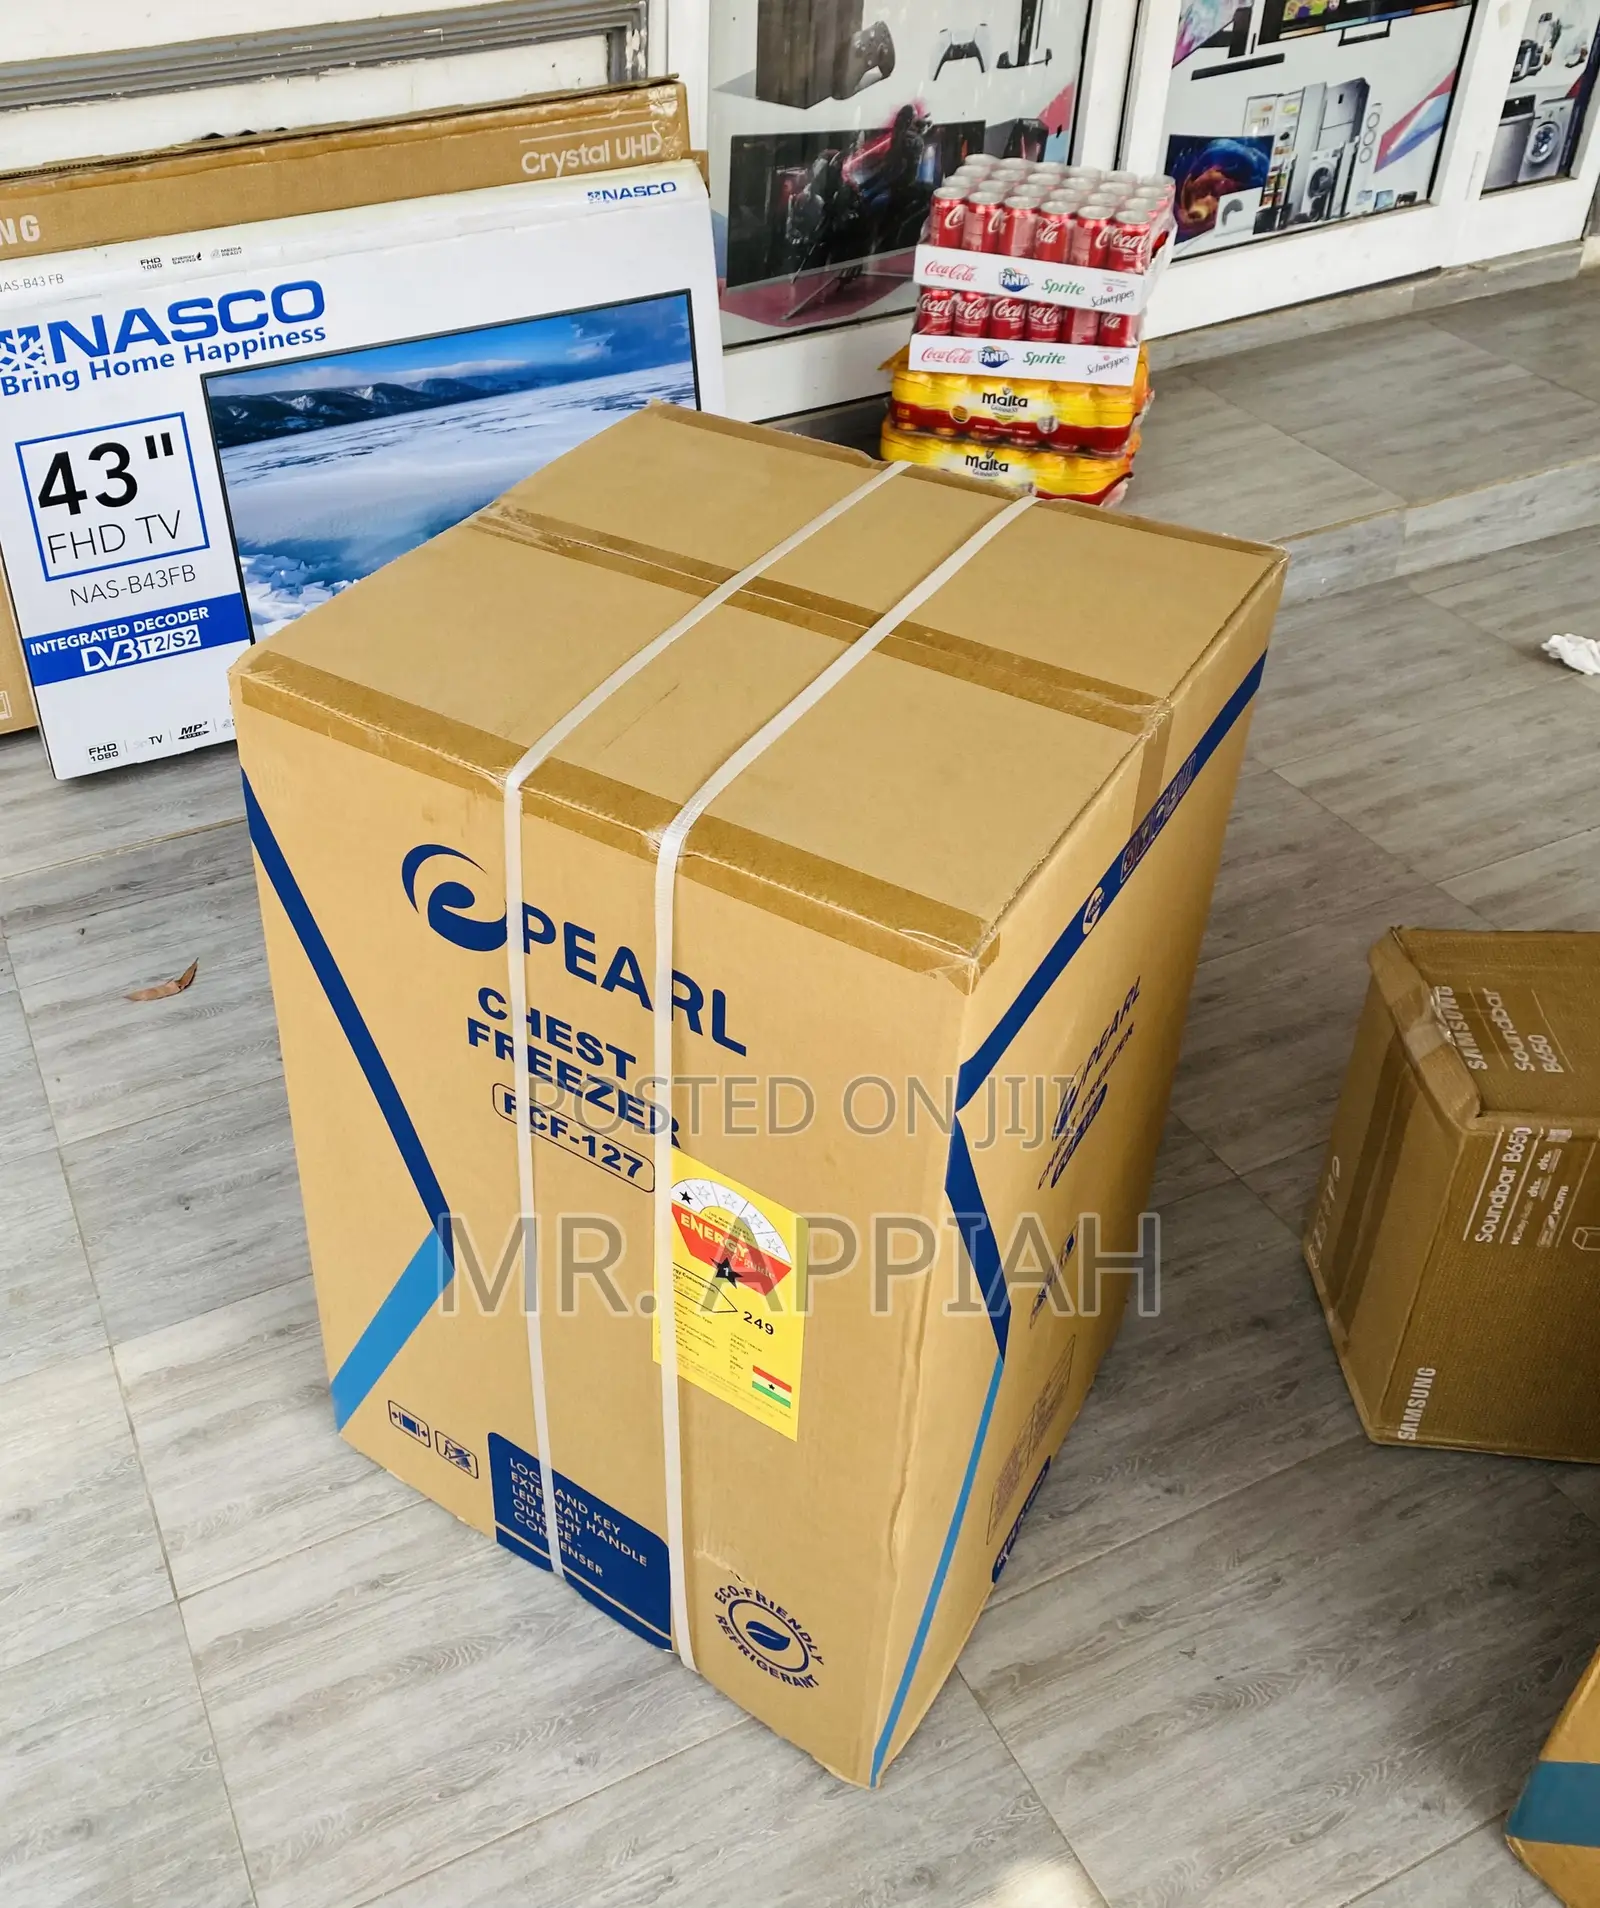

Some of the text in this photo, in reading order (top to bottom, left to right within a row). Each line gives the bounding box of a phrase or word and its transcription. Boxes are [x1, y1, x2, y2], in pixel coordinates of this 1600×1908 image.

[521, 133, 662, 177] Crystal UHD
[602, 181, 677, 200] NASCO
[48, 273, 64, 285] FB
[140, 257, 161, 266] FHD
[924, 260, 978, 283] Coca-Cola
[999, 271, 1031, 287] FANTA
[1041, 279, 1085, 296] Sprite
[47, 279, 327, 364] NASCO
[1, 325, 327, 397] Bring Home Happiness
[920, 347, 974, 364] Coca-Cola
[978, 349, 1010, 364] FANTA
[1023, 351, 1065, 366] Sprite
[982, 392, 1029, 408] Malta
[37, 432, 174, 516] 43"
[965, 454, 1009, 473] Malta
[47, 509, 181, 564] FHD TV
[69, 563, 196, 606] NAS-B43FB
[30, 607, 209, 656] INTEGRATED DECODER
[88, 743, 117, 756] FHD
[90, 750, 119, 762] 1080
[521, 901, 747, 1057] PEARL
[478, 987, 636, 1081] CHEST
[1434, 985, 1488, 1070] SAMSUNG
[1482, 987, 1536, 1072] Soundbar
[1528, 1034, 1564, 1073] B650
[467, 1016, 681, 1149] FREEZER
[1475, 1127, 1532, 1242] Soundbar B650
[681, 1213, 749, 1262] ENERGY
[743, 1311, 774, 1335] 249
[1397, 1367, 1436, 1441] SAMSUNG
[510, 1458, 620, 1535] LOC AND KEY
[511, 1472, 647, 1567] EXTENAL HANDLE
[512, 1485, 536, 1506] LED
[514, 1512, 603, 1577] CONENSER
[714, 1585, 824, 1665] ECO-FRIENDLY
[715, 1612, 819, 1688] REFRIGERANT
